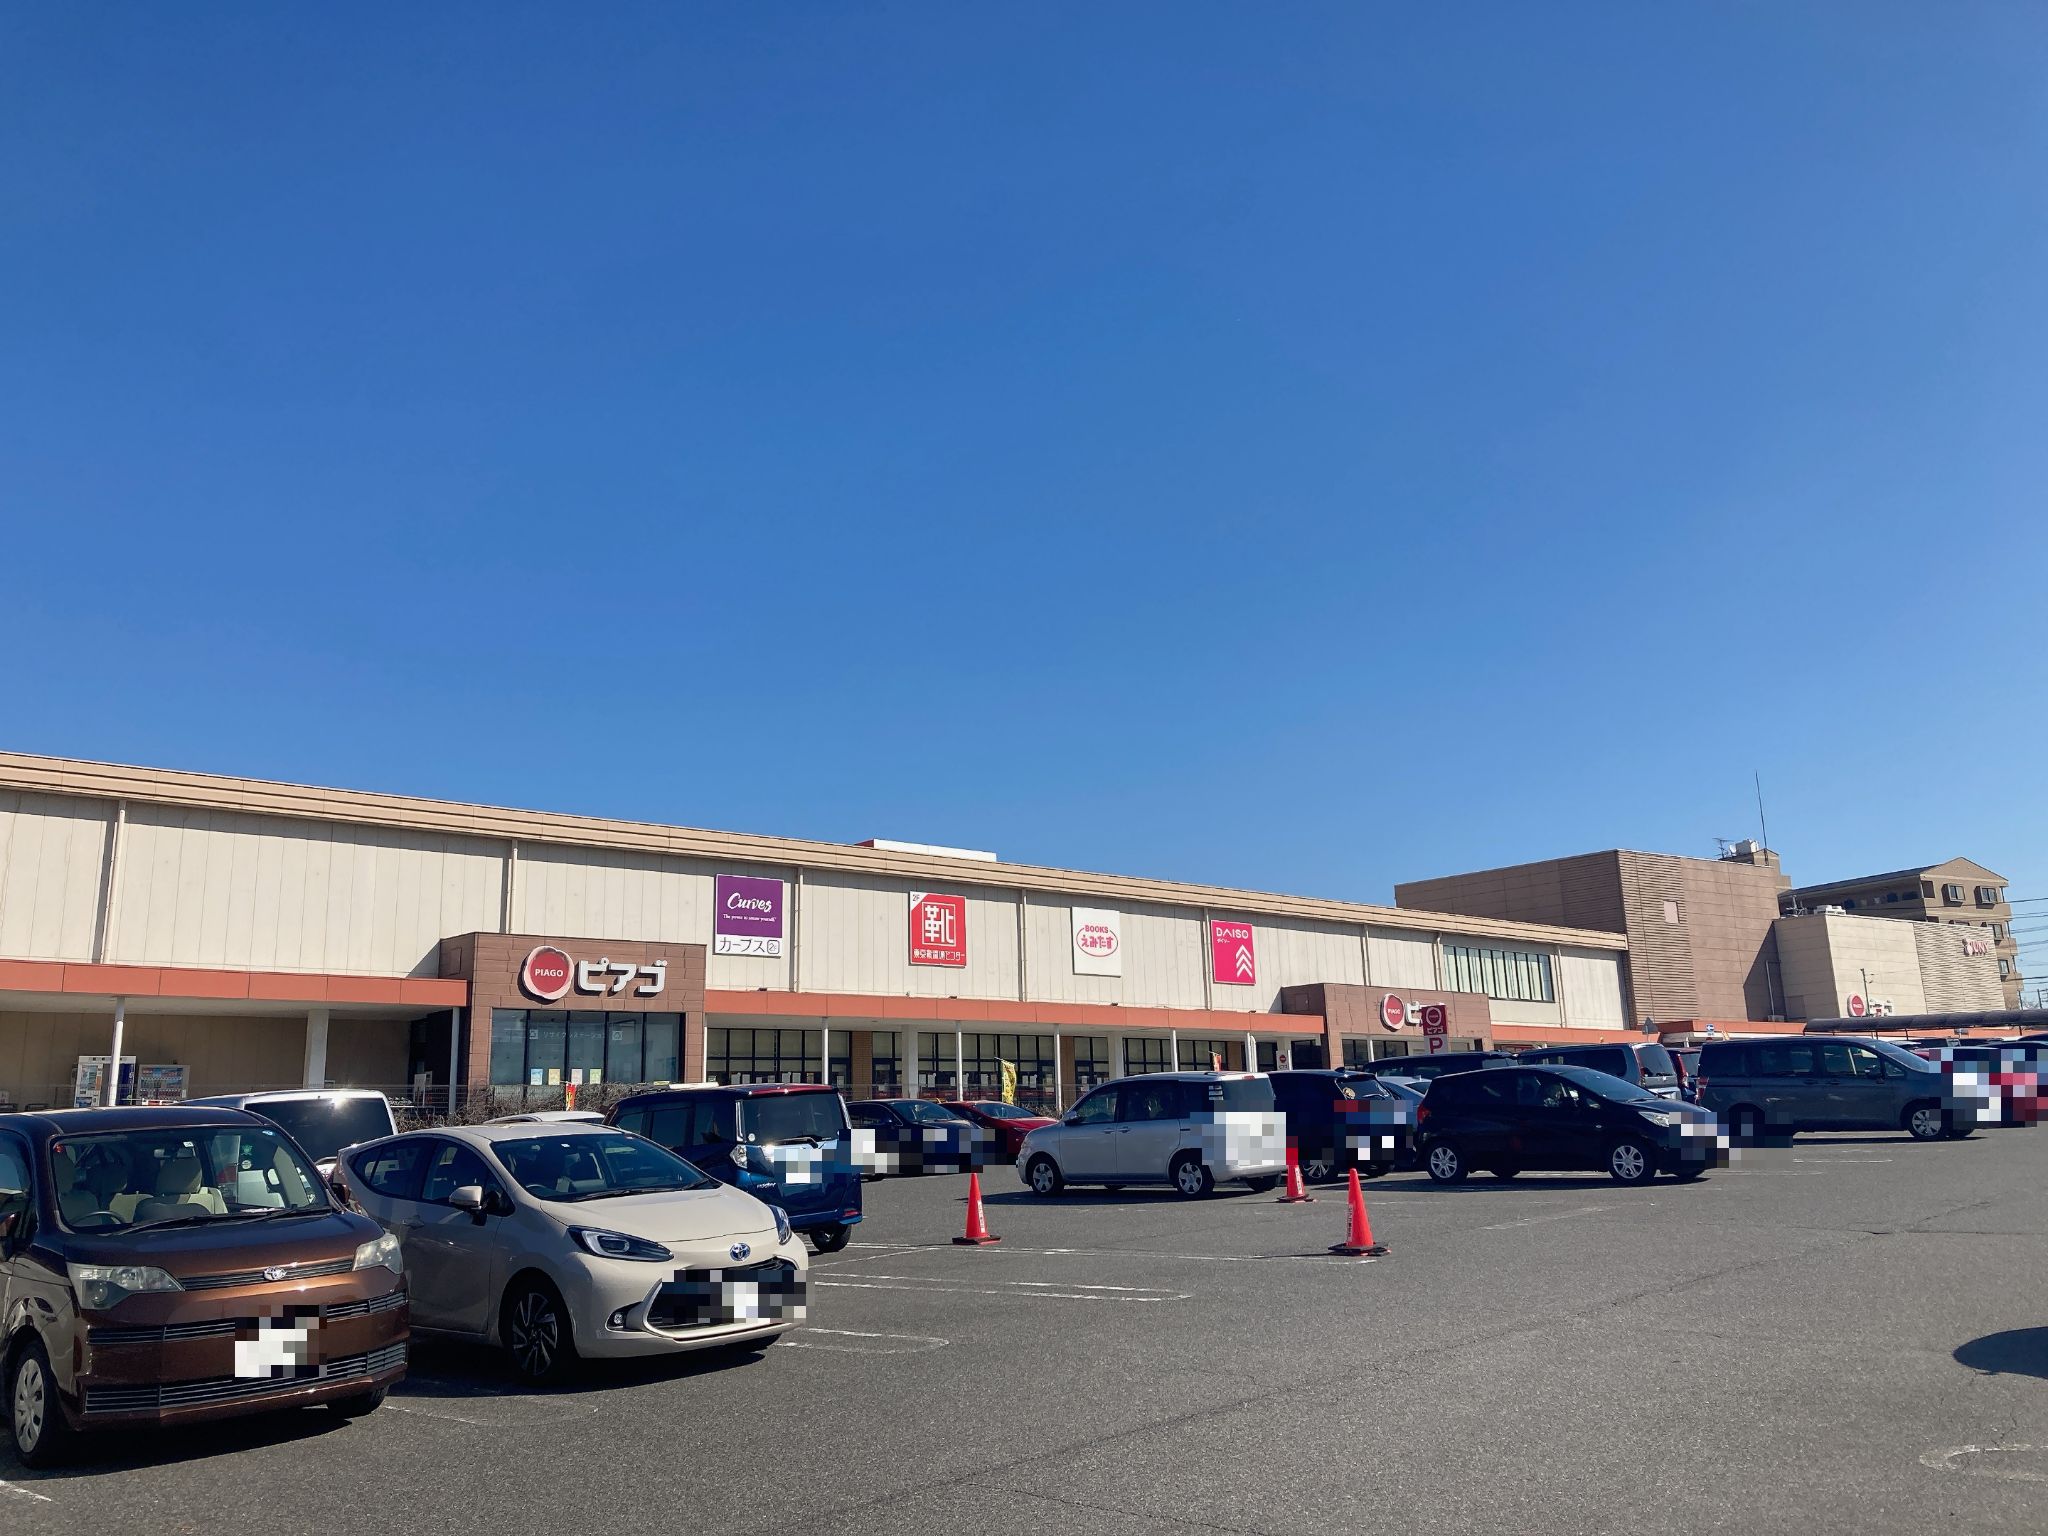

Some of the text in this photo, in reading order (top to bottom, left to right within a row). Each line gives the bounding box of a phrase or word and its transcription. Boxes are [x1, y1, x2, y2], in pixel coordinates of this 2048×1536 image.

[727, 892, 772, 913] Curves
[924, 905, 954, 943] 靴
[1084, 924, 1109, 934] BOOKS
[1215, 926, 1249, 940] DAISO
[719, 937, 765, 953] カーブス
[1081, 934, 1114, 949] えみたす
[534, 968, 564, 977] PIAGO
[578, 957, 668, 993] ピアゴ
[1426, 1025, 1444, 1035] ピアゴ
[1429, 1037, 1443, 1054] P
